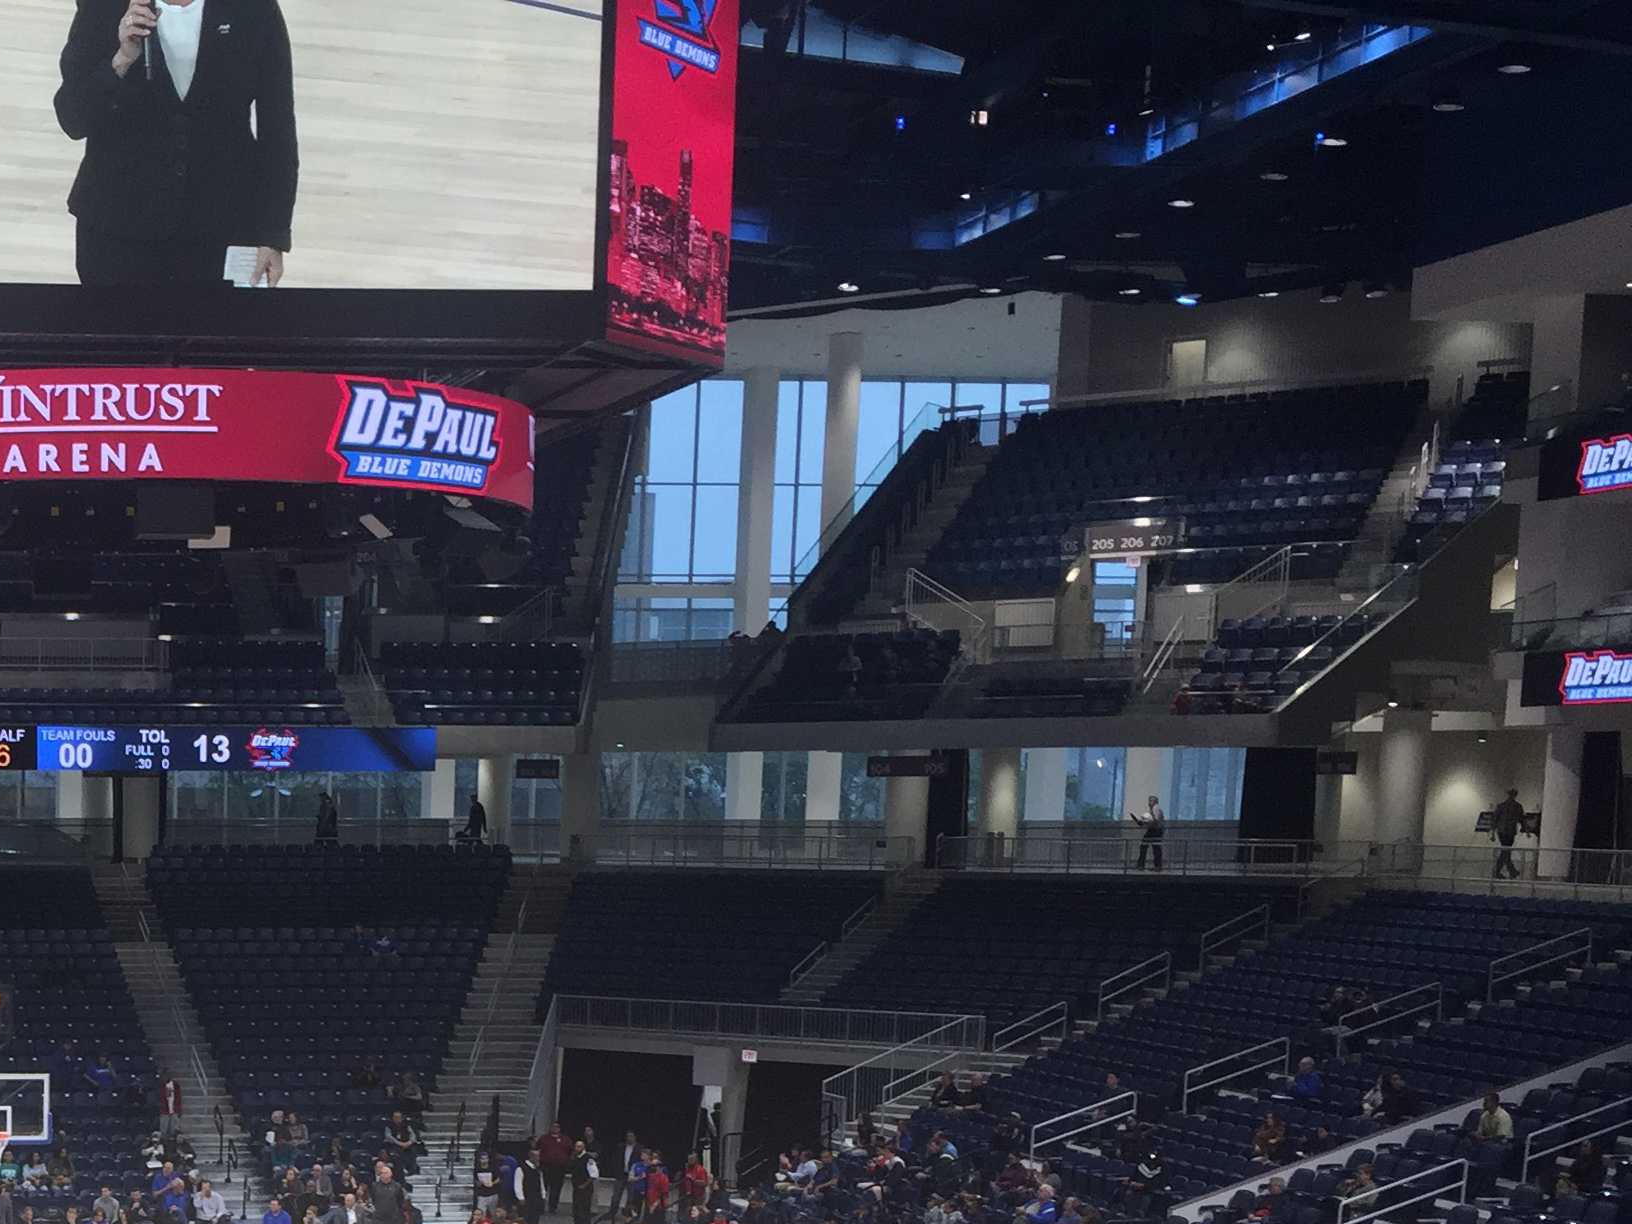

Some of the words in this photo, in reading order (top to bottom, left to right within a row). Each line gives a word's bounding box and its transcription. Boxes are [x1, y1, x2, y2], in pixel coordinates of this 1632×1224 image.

[644, 26, 673, 49] BLUE
[674, 40, 718, 69] DEMONS
[2, 443, 164, 473] ARENA
[356, 455, 412, 476] BLUE
[418, 460, 484, 485] DEMONS
[1092, 538, 1115, 551] 205
[1120, 536, 1144, 549] 206
[1150, 535, 1175, 548] 207
[41, 728, 74, 741] TEAM
[76, 728, 116, 741] FOULS
[139, 729, 170, 743] TOL
[58, 743, 93, 769] 00
[125, 745, 155, 756] FULL
[161, 745, 170, 756] 0
[193, 734, 230, 763] 13
[161, 758, 170, 770] 0
